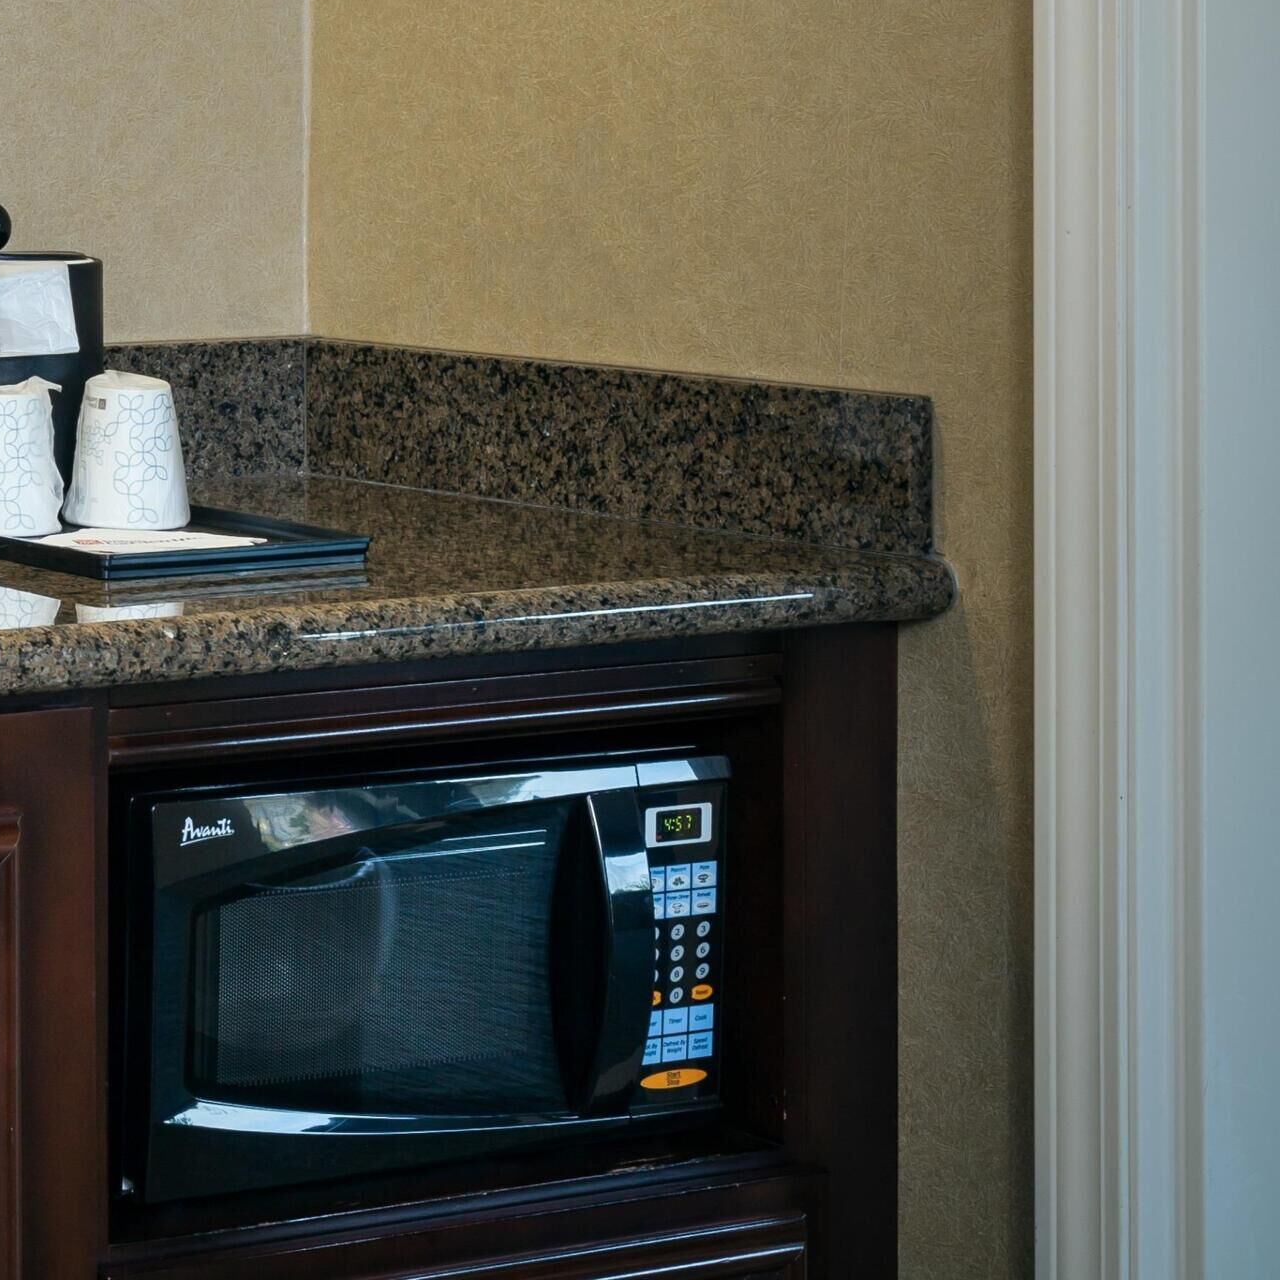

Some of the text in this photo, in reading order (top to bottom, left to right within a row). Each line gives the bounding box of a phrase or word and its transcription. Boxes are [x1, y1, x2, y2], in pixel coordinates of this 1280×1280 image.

[664, 815, 692, 832] 4:57
[181, 816, 233, 843] Avanti
[674, 928, 681, 936] 2
[700, 925, 706, 933] 3
[674, 949, 680, 957] 5
[674, 970, 680, 978] 8
[699, 967, 706, 975] 9
